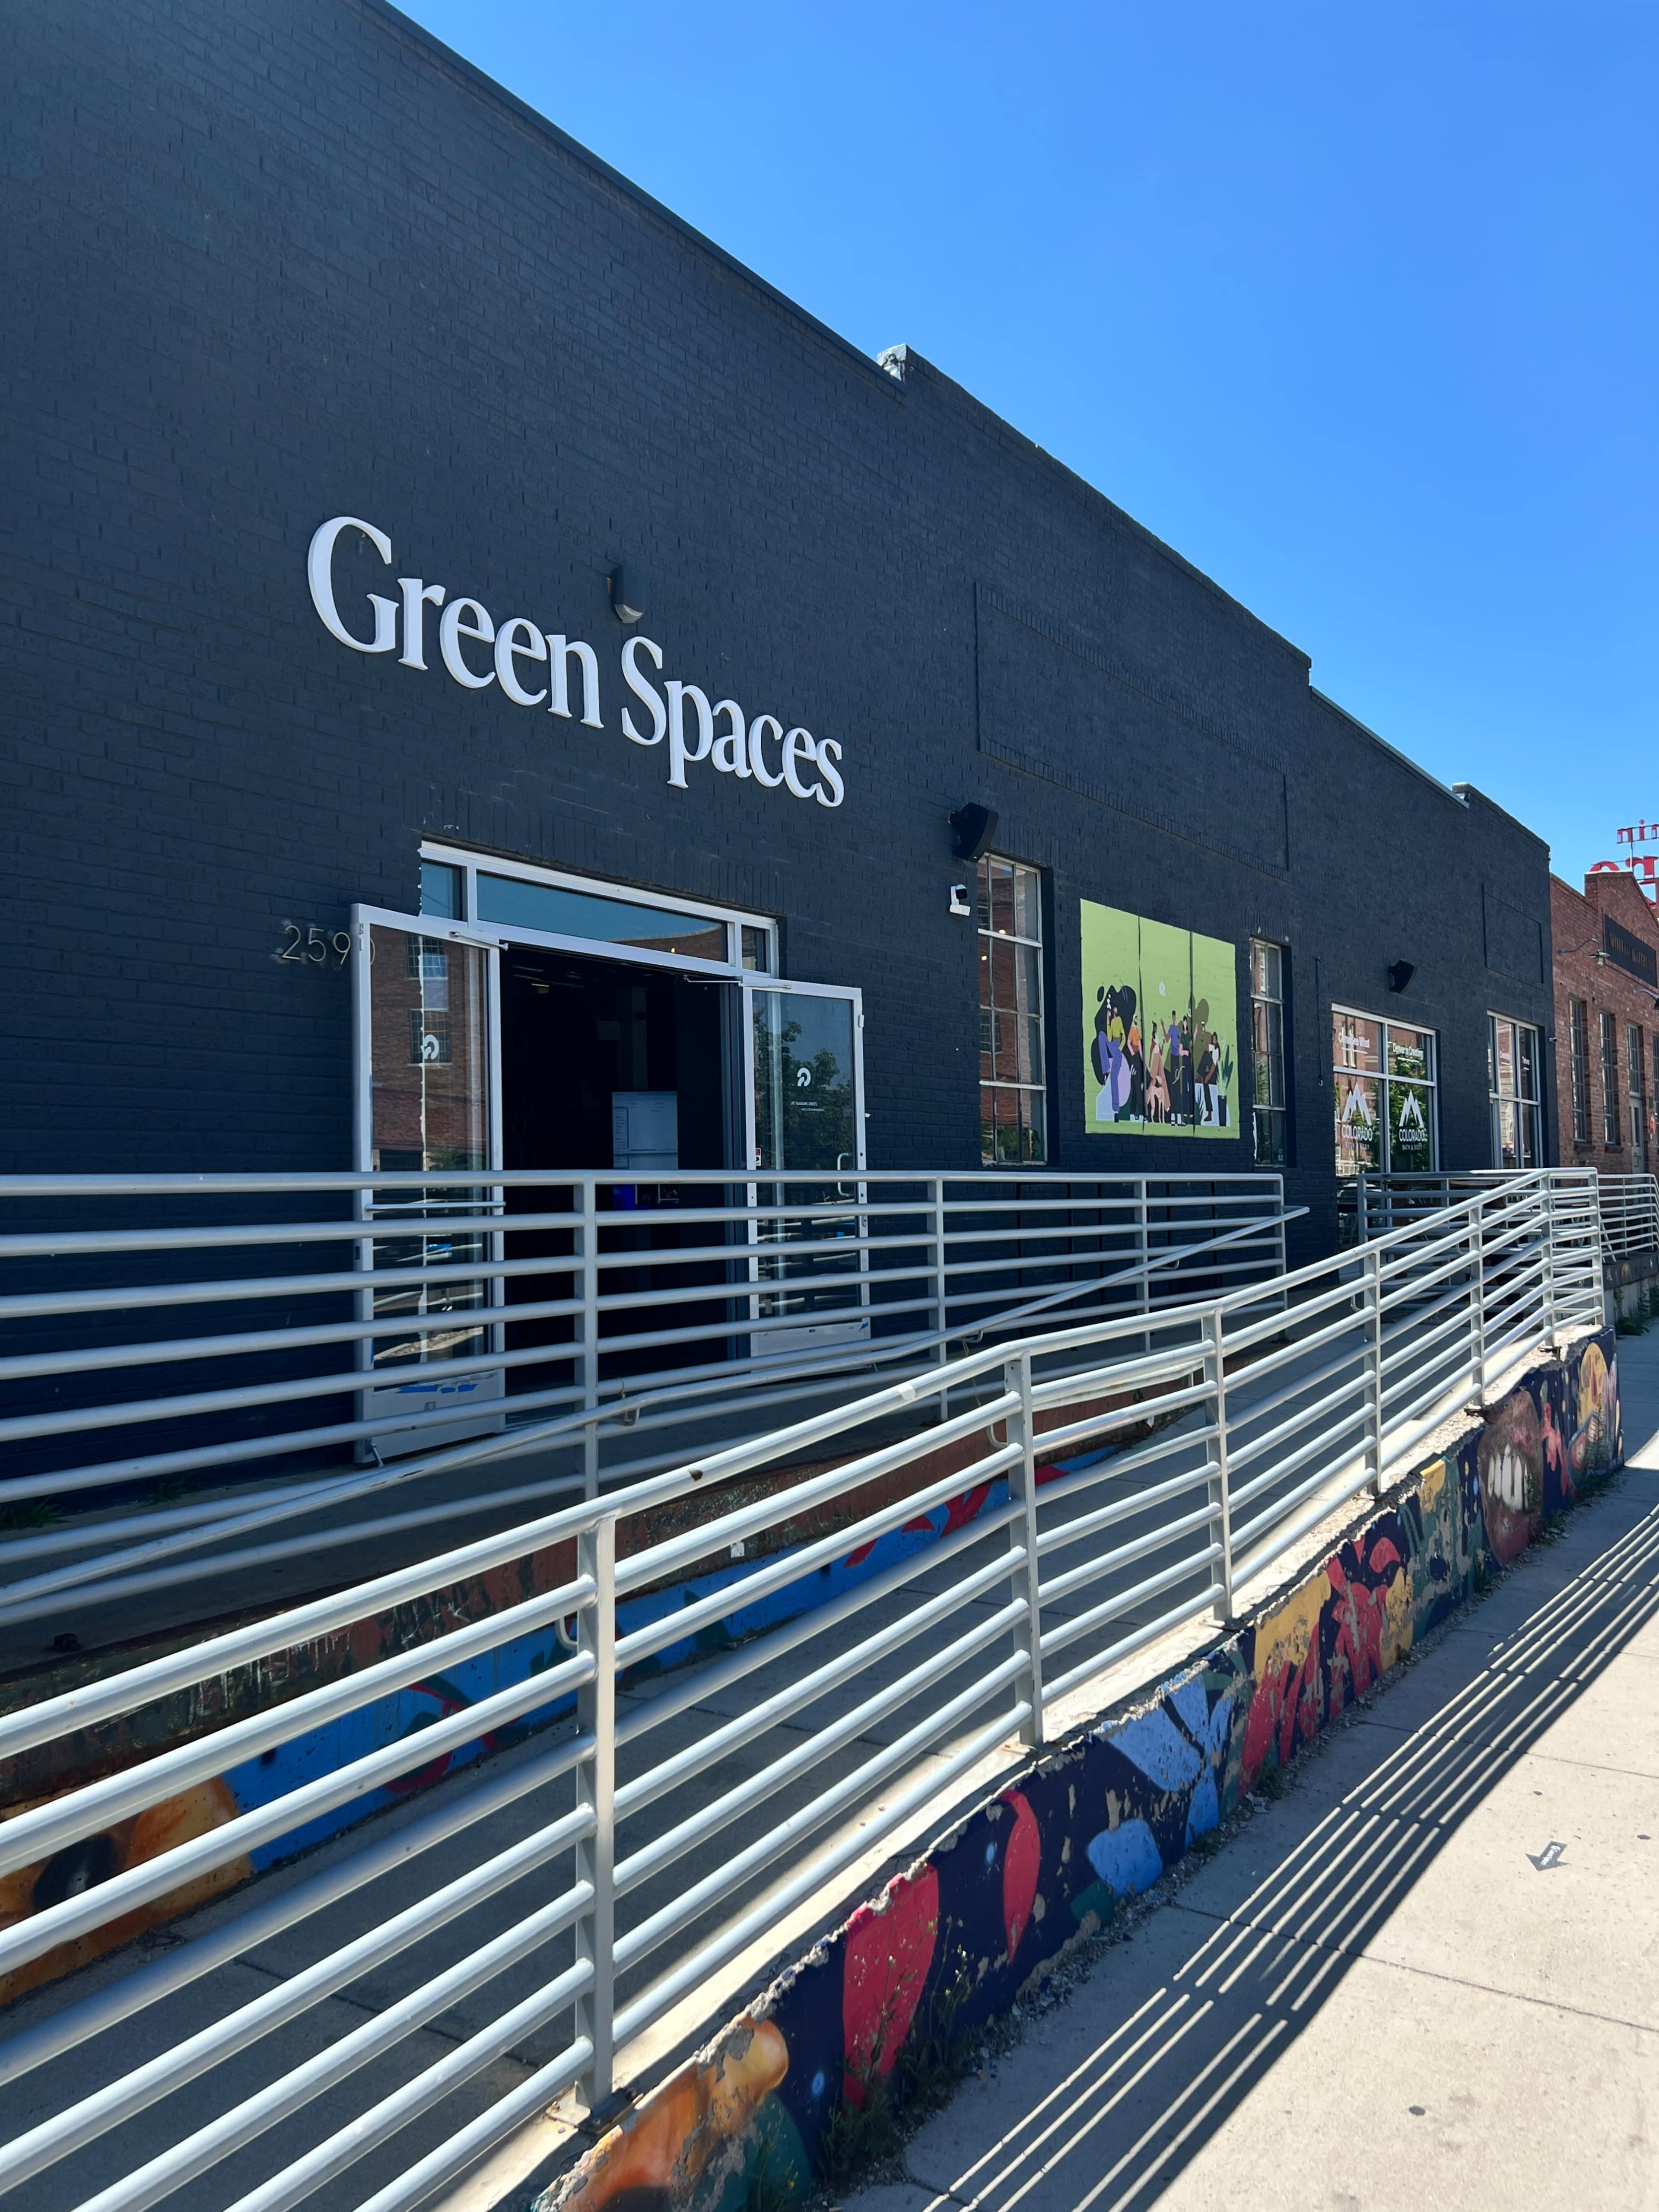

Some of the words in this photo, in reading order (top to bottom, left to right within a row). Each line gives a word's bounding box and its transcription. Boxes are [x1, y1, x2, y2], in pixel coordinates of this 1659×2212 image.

[307, 516, 604, 728] Green
[621, 636, 844, 807] Spaces
[281, 925, 375, 965] 259
[1341, 1124, 1373, 1141] COLORADO
[1399, 1128, 1425, 1142] COLORADO
